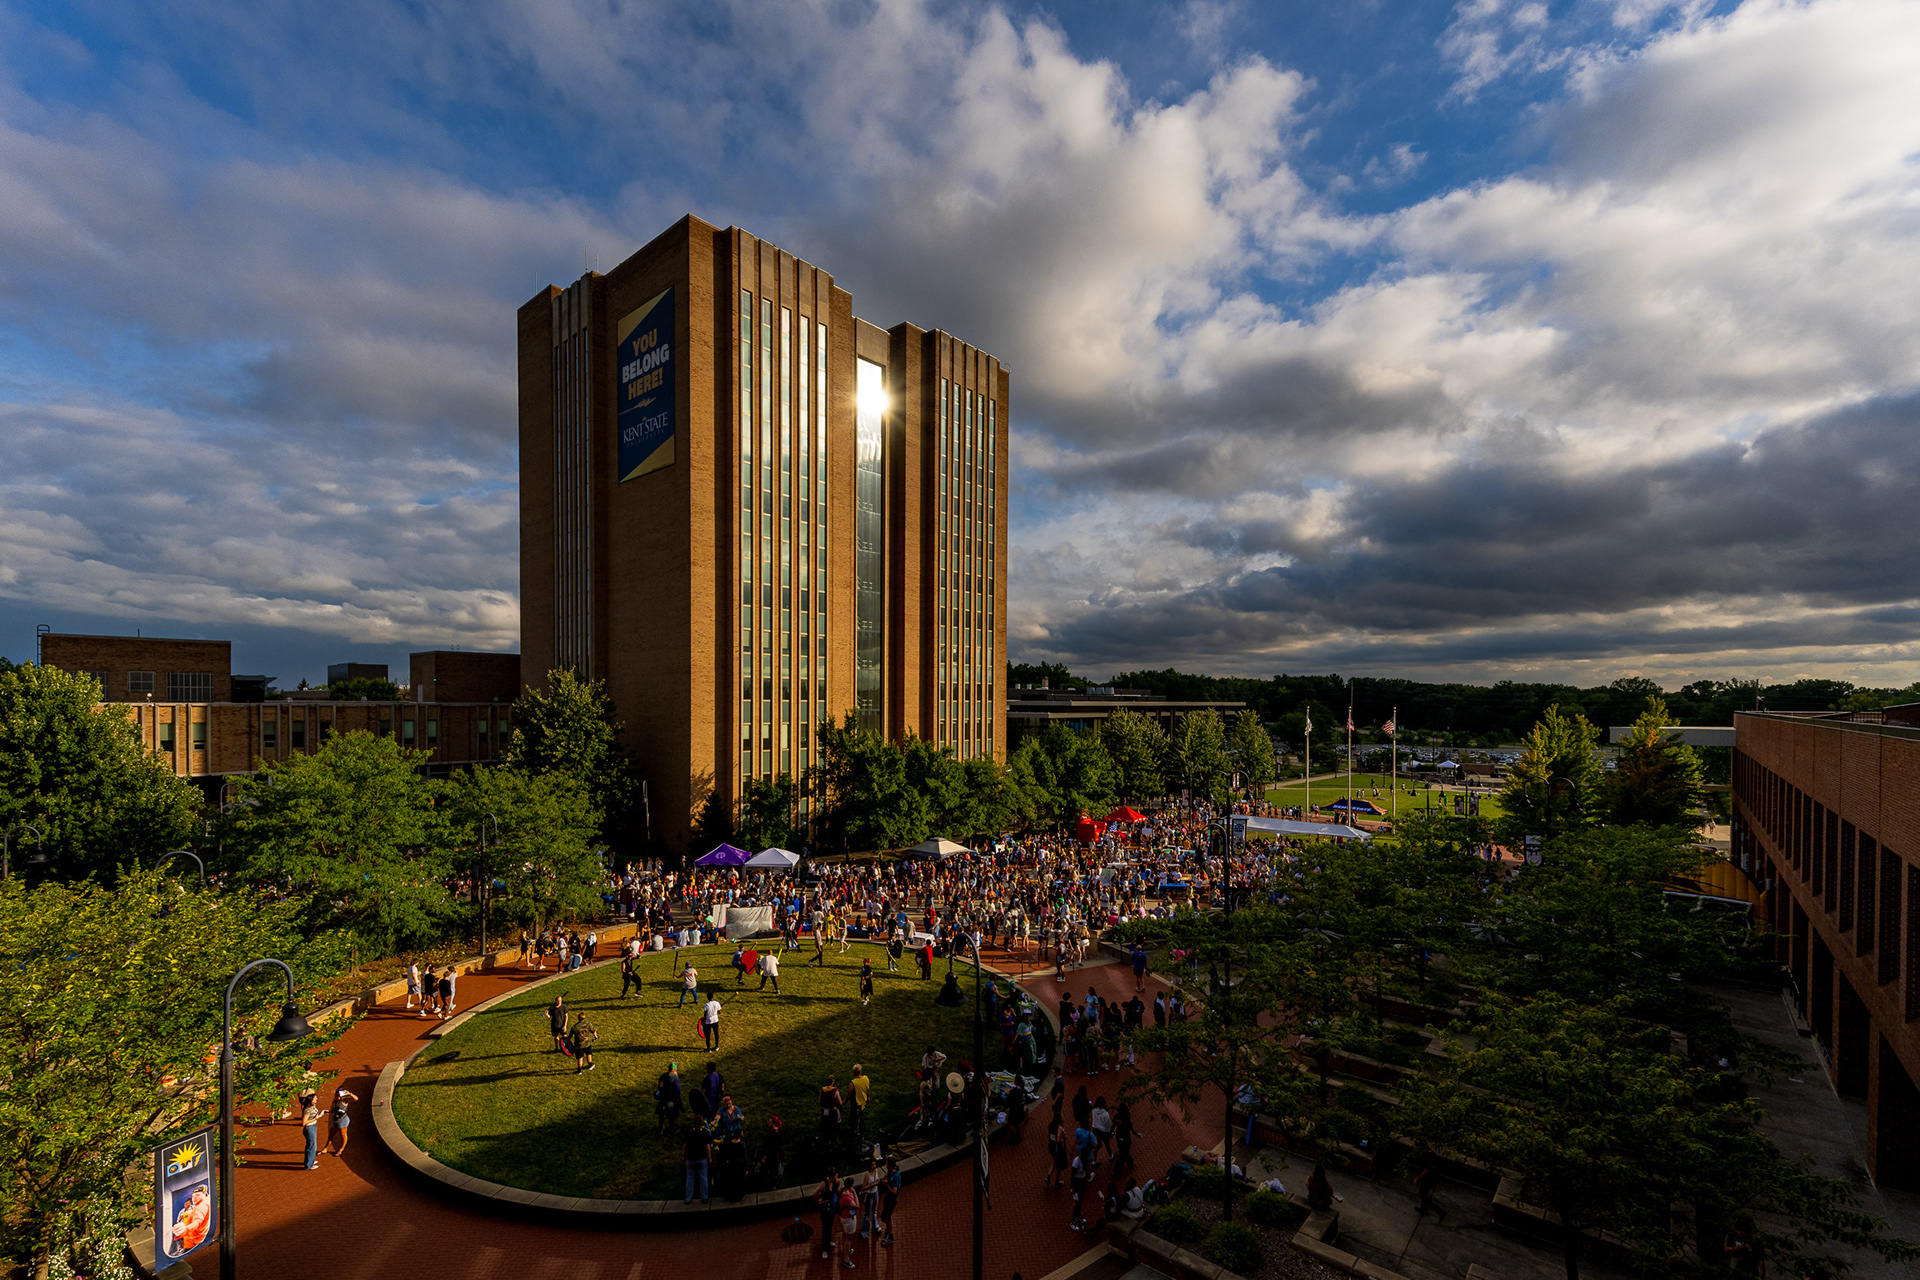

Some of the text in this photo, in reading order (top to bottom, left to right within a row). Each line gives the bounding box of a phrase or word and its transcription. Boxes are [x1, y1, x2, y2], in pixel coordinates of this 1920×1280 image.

[632, 327, 658, 357] YOU
[622, 344, 670, 384] BELONG
[628, 366, 663, 401] HERE!
[623, 411, 668, 443] KENT STATE
